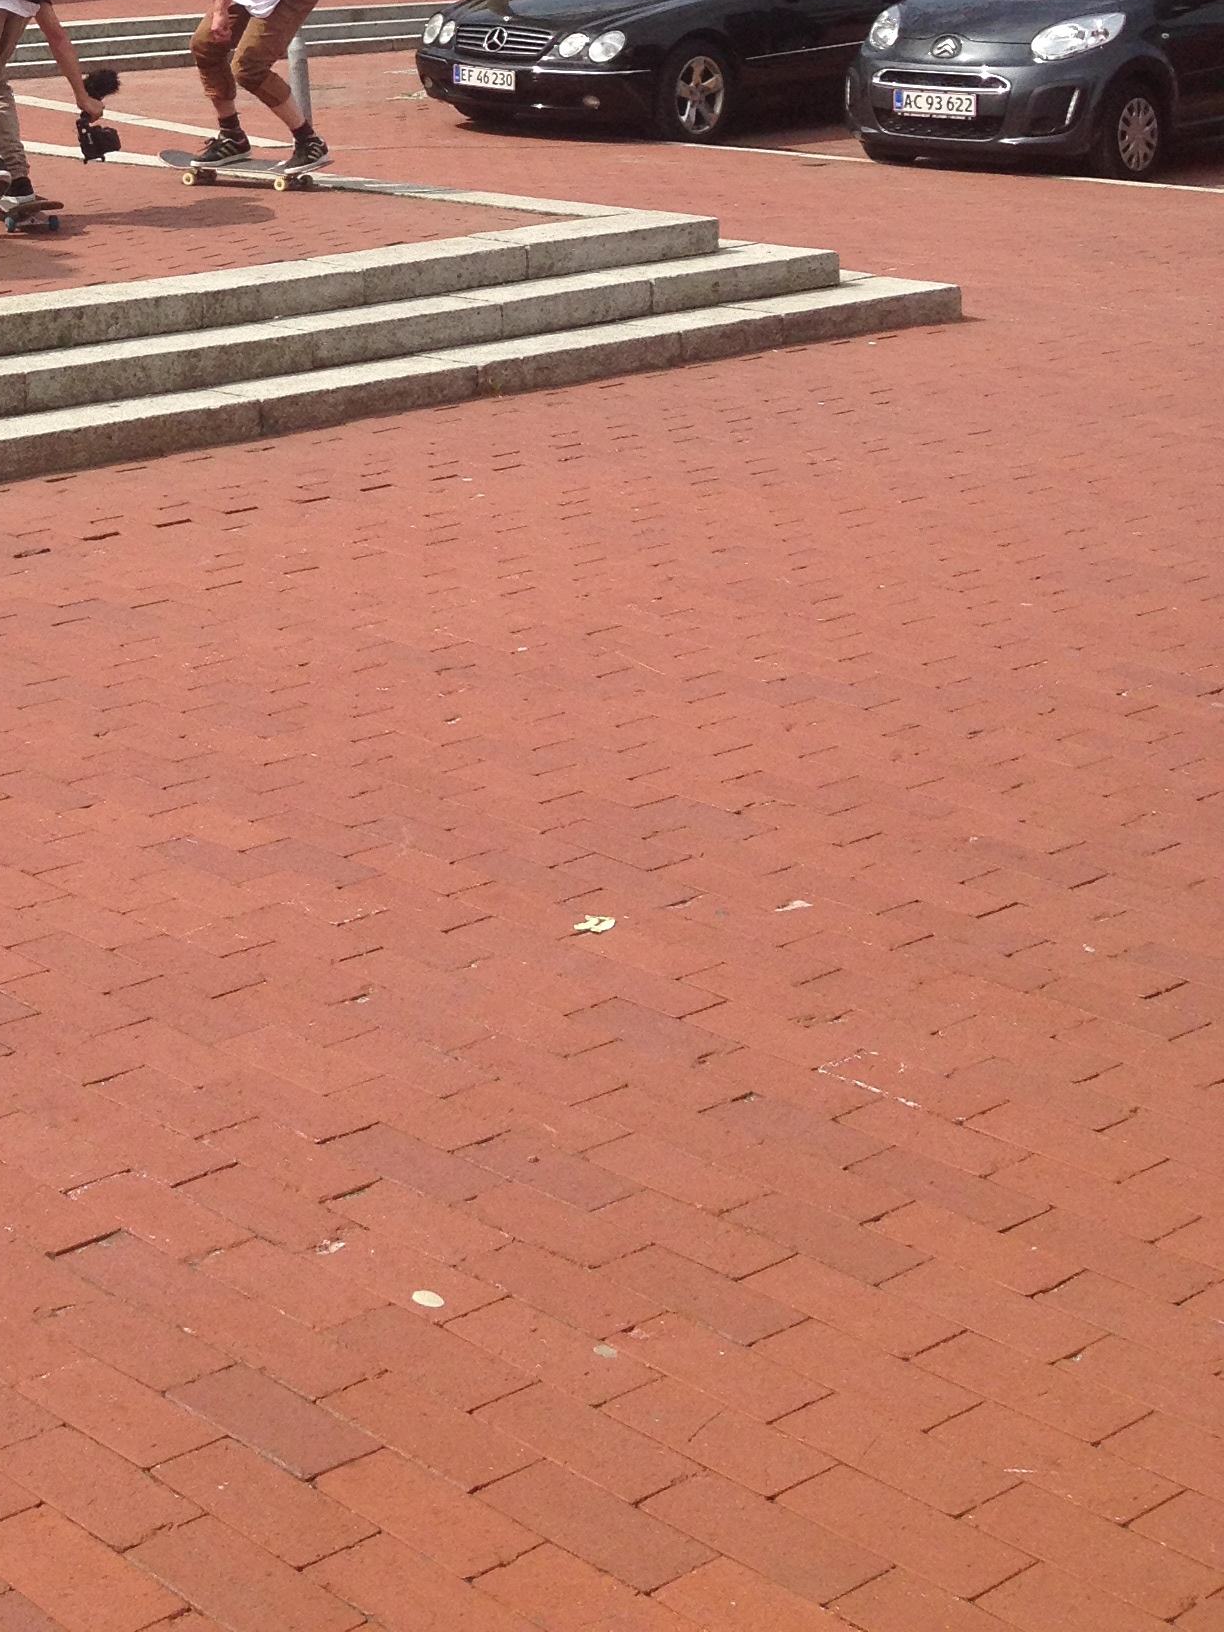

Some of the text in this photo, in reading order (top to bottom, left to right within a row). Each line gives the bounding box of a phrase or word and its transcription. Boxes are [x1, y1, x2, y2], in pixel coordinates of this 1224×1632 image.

[461, 68, 512, 86] EF 46 230
[904, 94, 973, 112] AC 93 622
